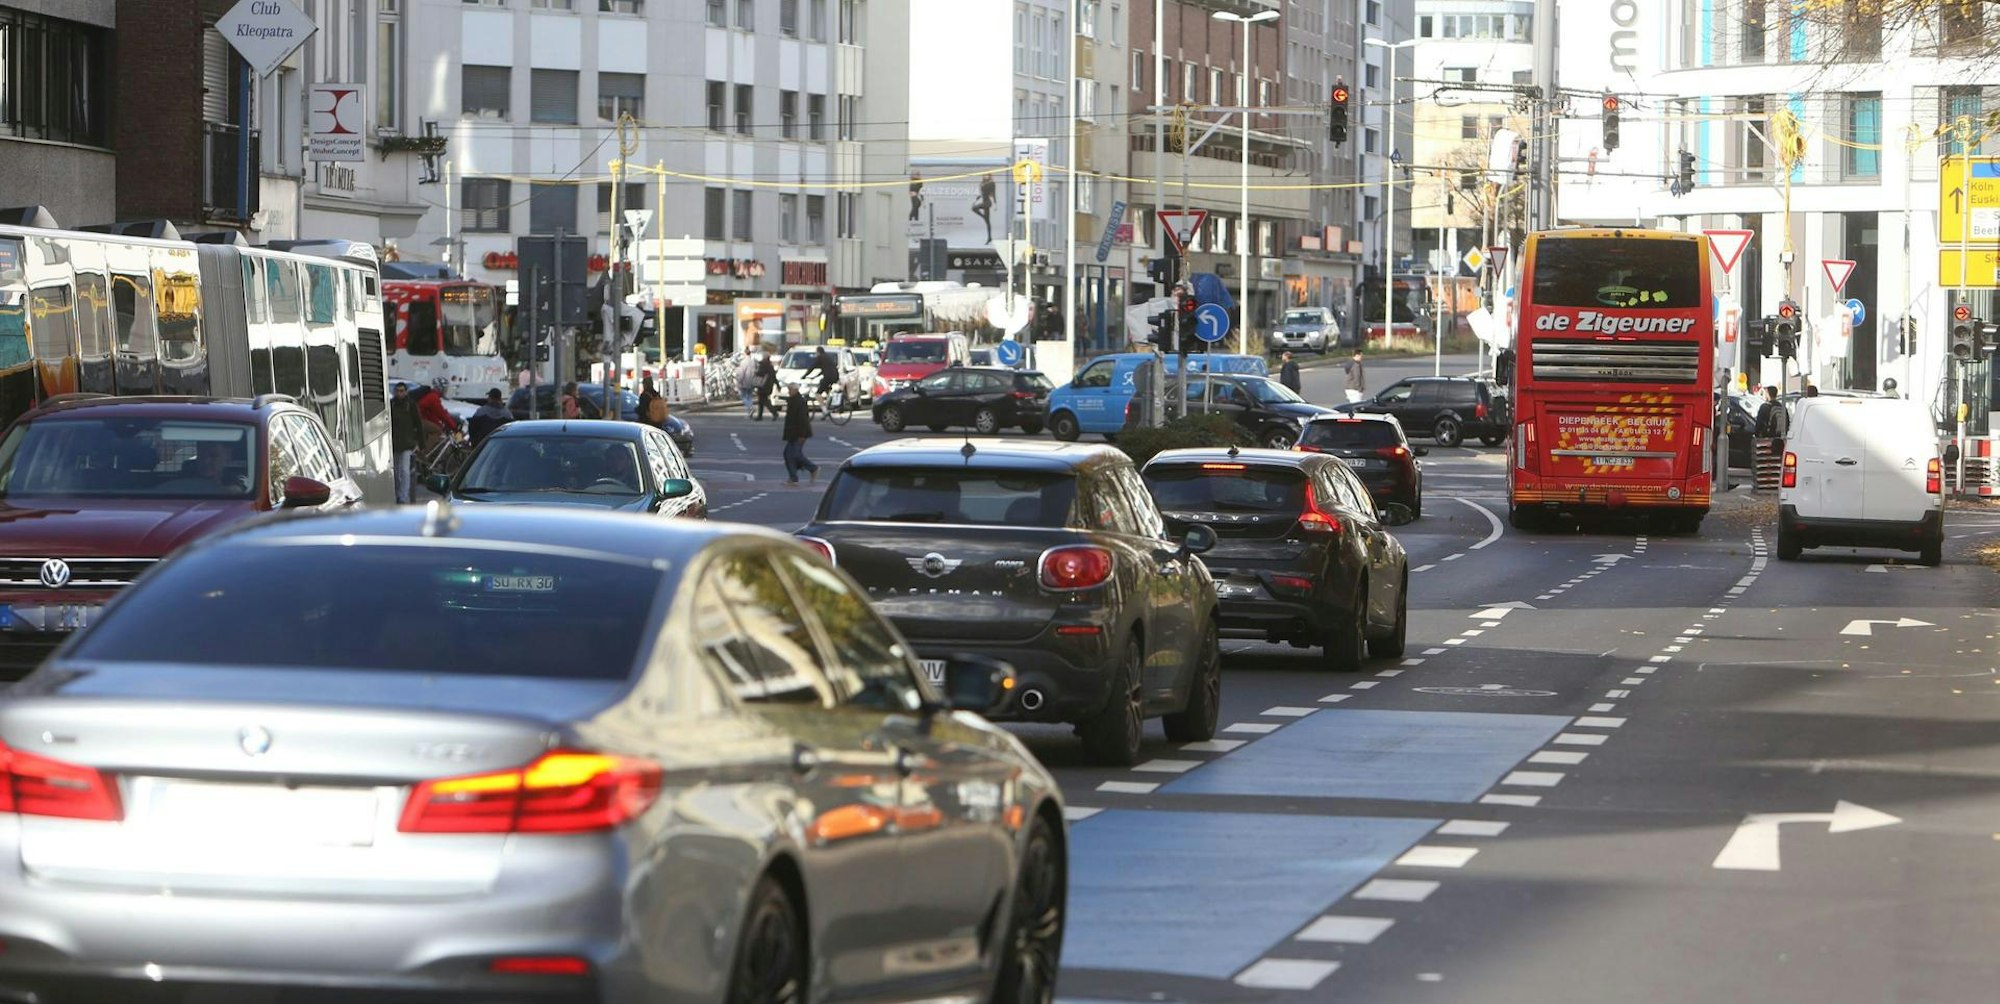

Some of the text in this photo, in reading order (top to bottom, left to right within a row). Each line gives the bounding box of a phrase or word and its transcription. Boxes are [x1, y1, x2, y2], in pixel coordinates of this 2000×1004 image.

[251, 1, 281, 16] Club
[236, 23, 294, 39] Kleopatra
[1970, 182, 1994, 191] Köln
[1536, 311, 1696, 334] de Zigeuner
[1173, 514, 1259, 522] VOLVO
[868, 586, 1002, 595] PACEMAN
